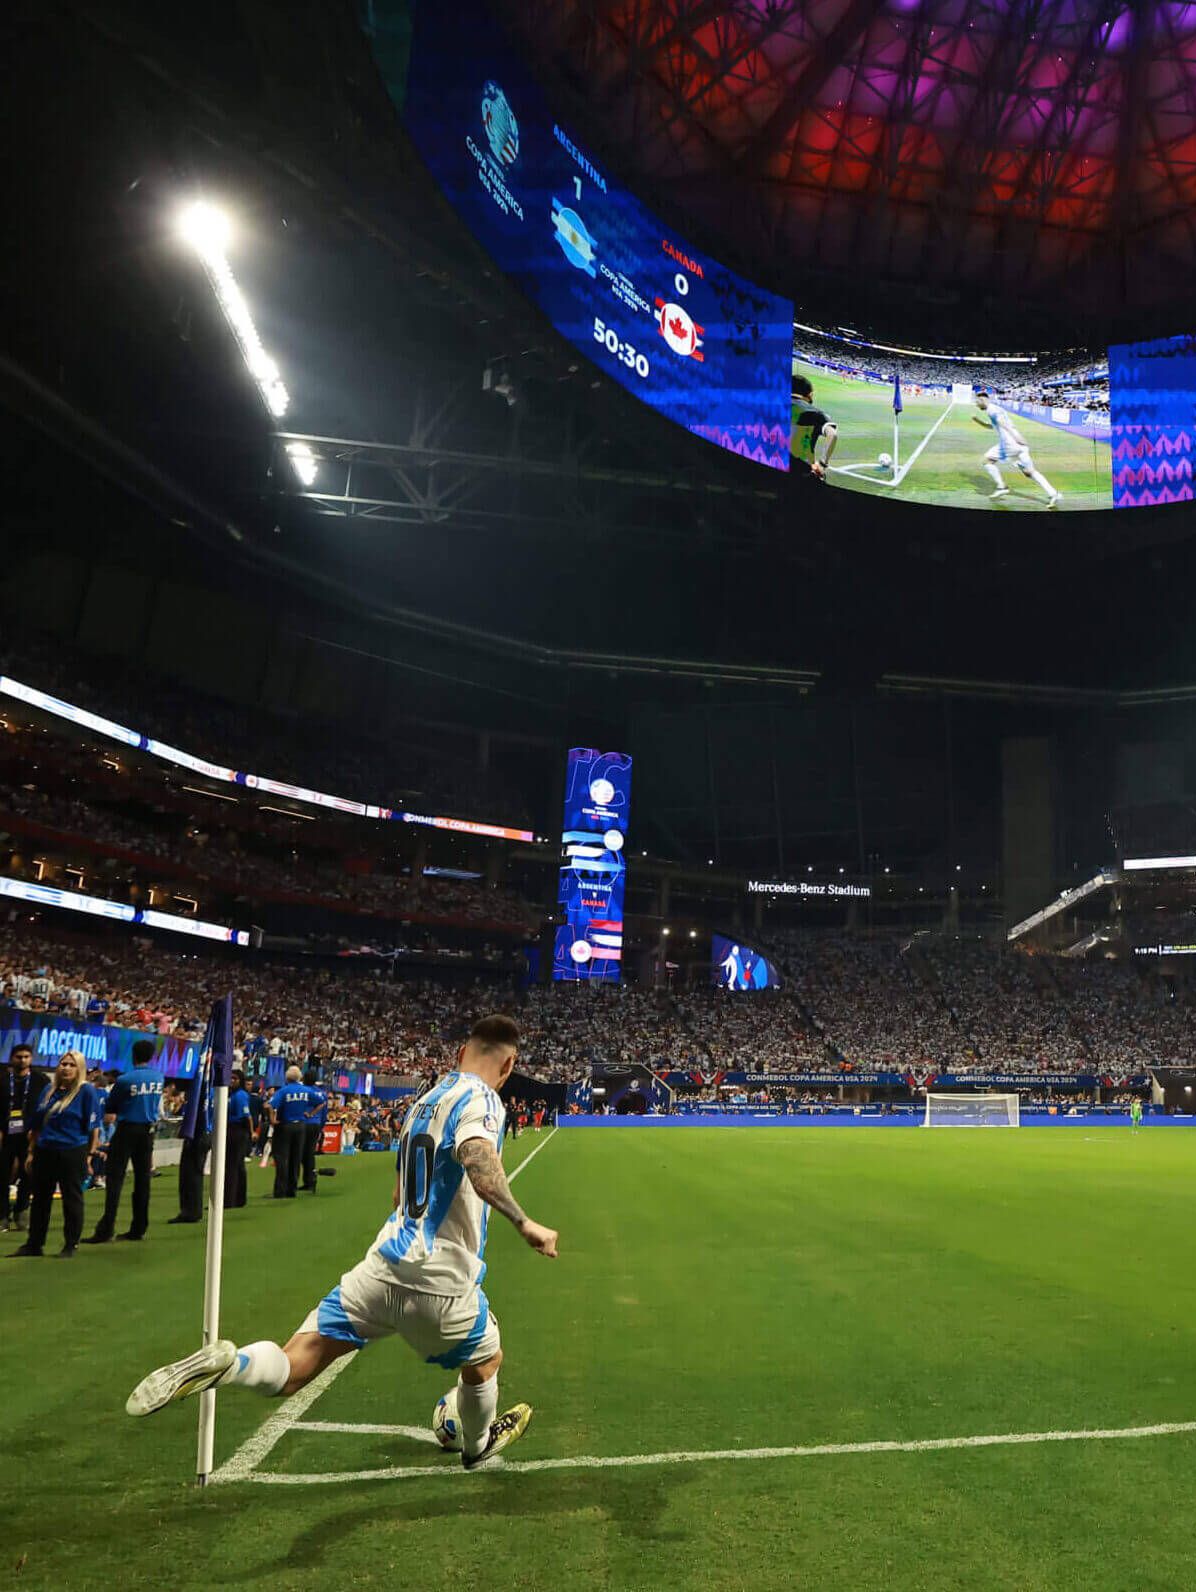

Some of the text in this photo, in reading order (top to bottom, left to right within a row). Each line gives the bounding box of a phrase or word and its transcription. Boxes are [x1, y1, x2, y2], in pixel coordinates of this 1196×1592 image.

[553, 124, 607, 194] ARGENTINA
[573, 176, 582, 200] 1
[662, 240, 704, 279] CANADA
[674, 273, 689, 296] 0
[593, 317, 650, 378] 50:30
[748, 881, 870, 896] Mercedes-Benz Stadium
[38, 1027, 107, 1062] ARGENTINA
[185, 1047, 194, 1073] 0
[746, 1074, 789, 1082] CONMEBOL
[790, 1074, 810, 1082] COPA
[811, 1074, 843, 1082] AMERICA
[401, 1132, 435, 1219] 10
